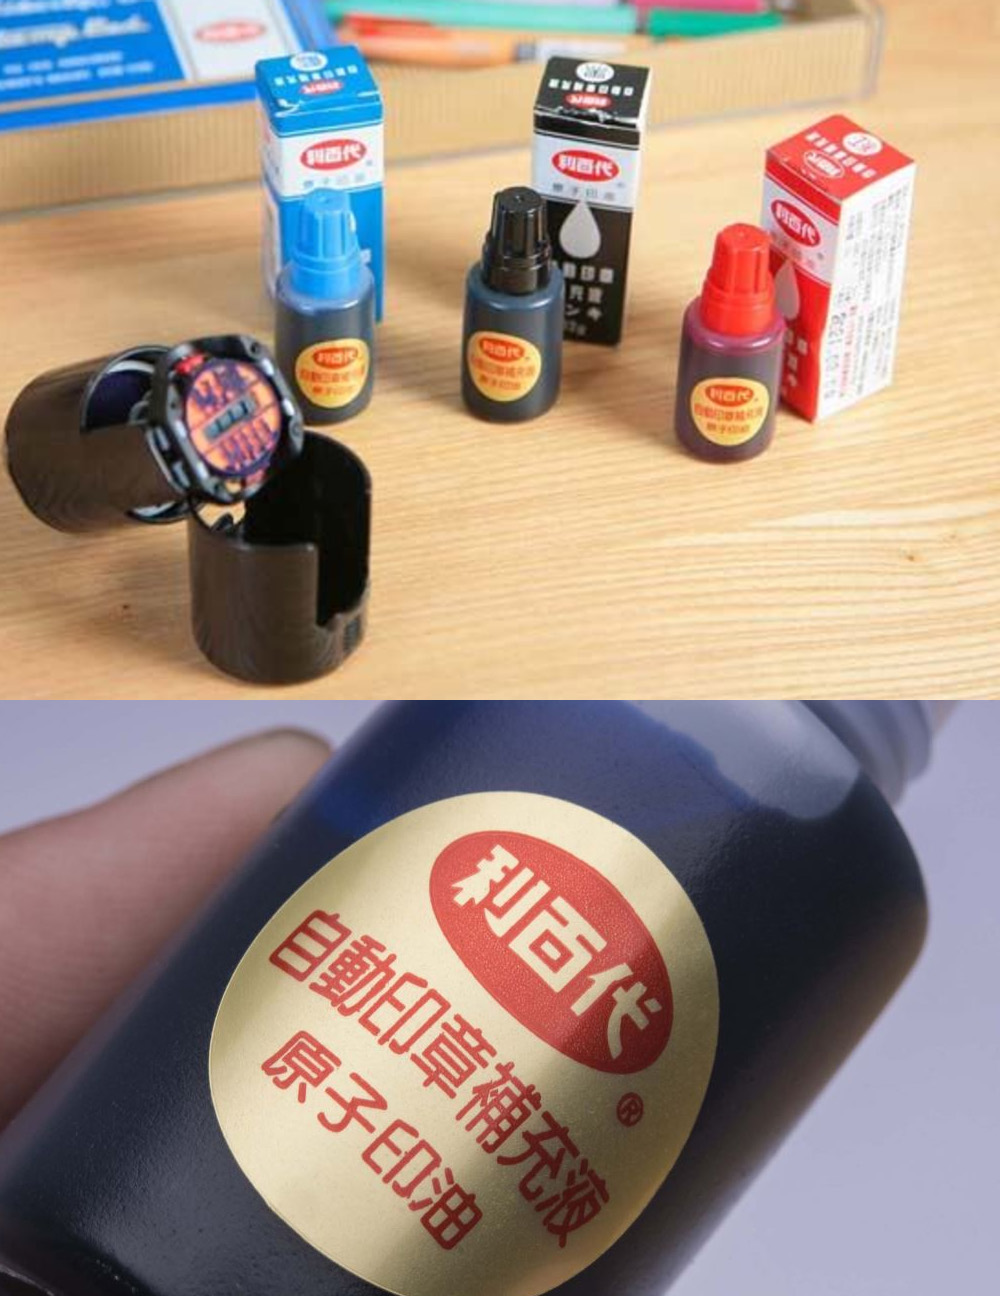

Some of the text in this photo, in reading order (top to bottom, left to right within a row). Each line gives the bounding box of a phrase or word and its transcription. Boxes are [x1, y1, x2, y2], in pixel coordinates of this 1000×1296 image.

[306, 143, 363, 165] 利百代
[558, 154, 614, 178] 利百代
[451, 844, 662, 1059] 利百代
[261, 1029, 482, 1251] 原子印油
[269, 909, 610, 1248] 自動印章補充液
